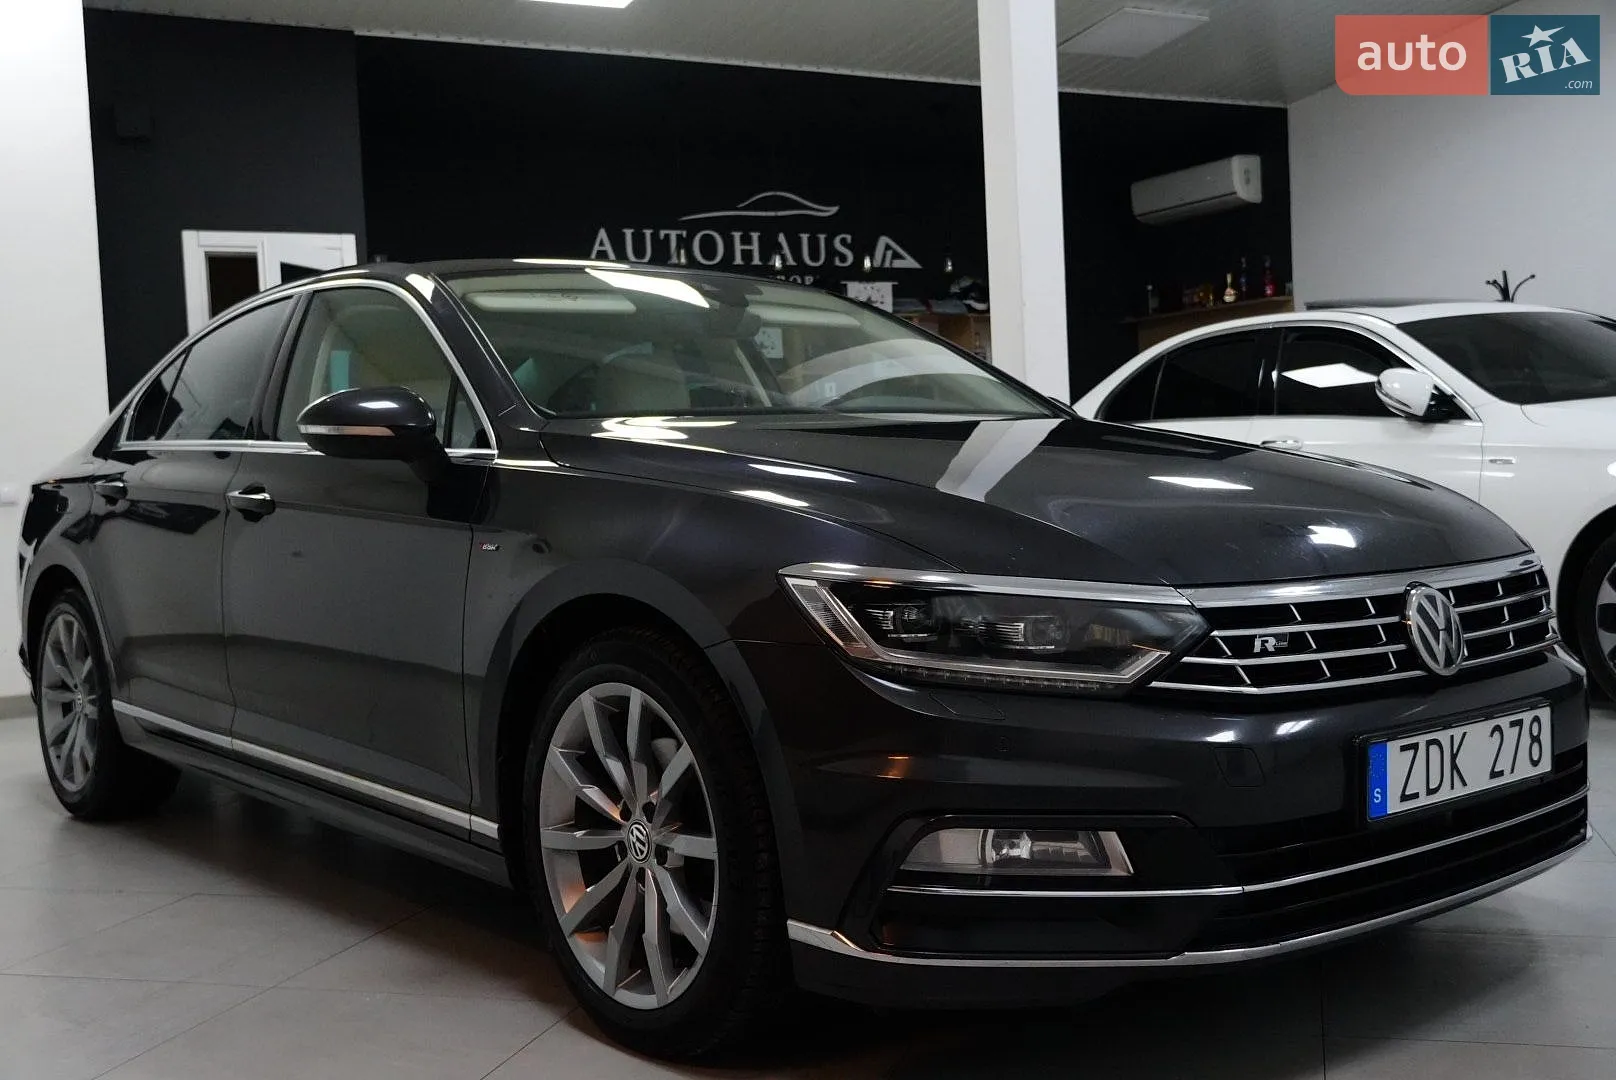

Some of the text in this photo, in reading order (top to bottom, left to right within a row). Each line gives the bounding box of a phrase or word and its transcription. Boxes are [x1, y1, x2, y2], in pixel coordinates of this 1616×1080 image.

[589, 227, 854, 267] AUTOHAUS
[1399, 714, 1543, 804] ZDK 278
[1373, 787, 1382, 804] S
